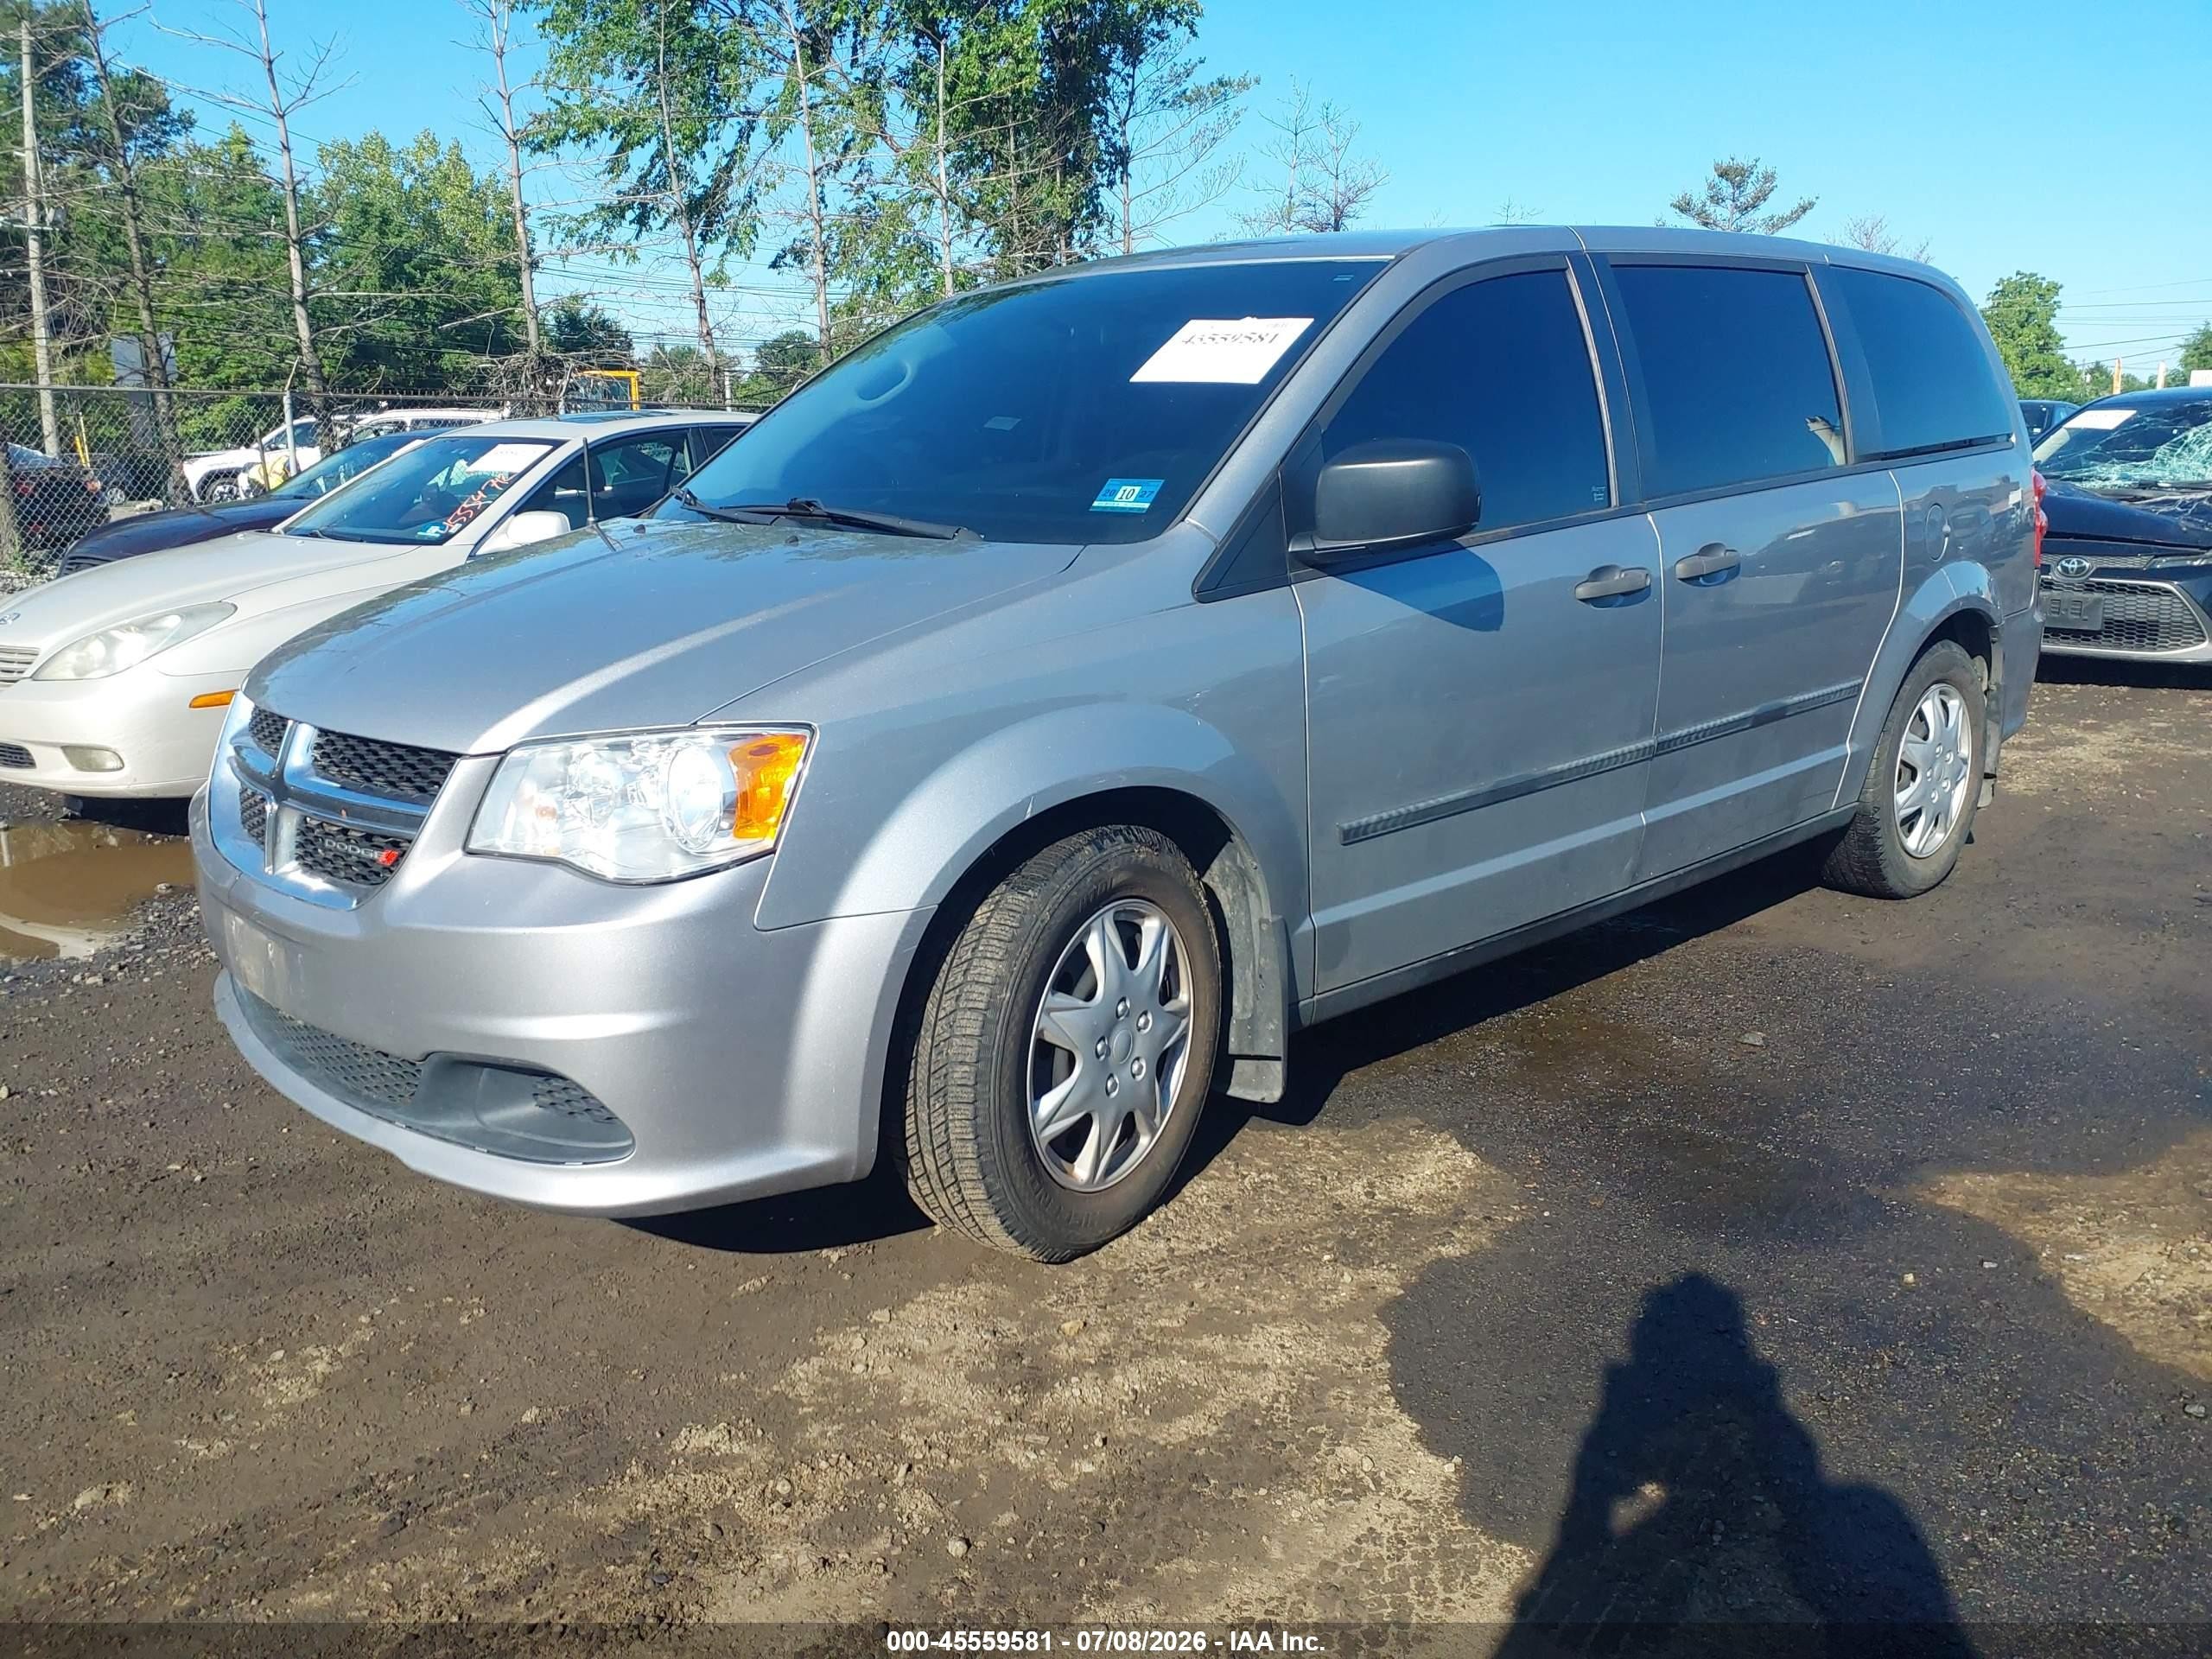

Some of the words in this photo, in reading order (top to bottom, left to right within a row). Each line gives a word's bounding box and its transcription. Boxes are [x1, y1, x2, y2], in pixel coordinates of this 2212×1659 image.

[1117, 487, 1136, 500] 10
[1140, 490, 1155, 499] 27
[324, 838, 384, 861] DODGE
